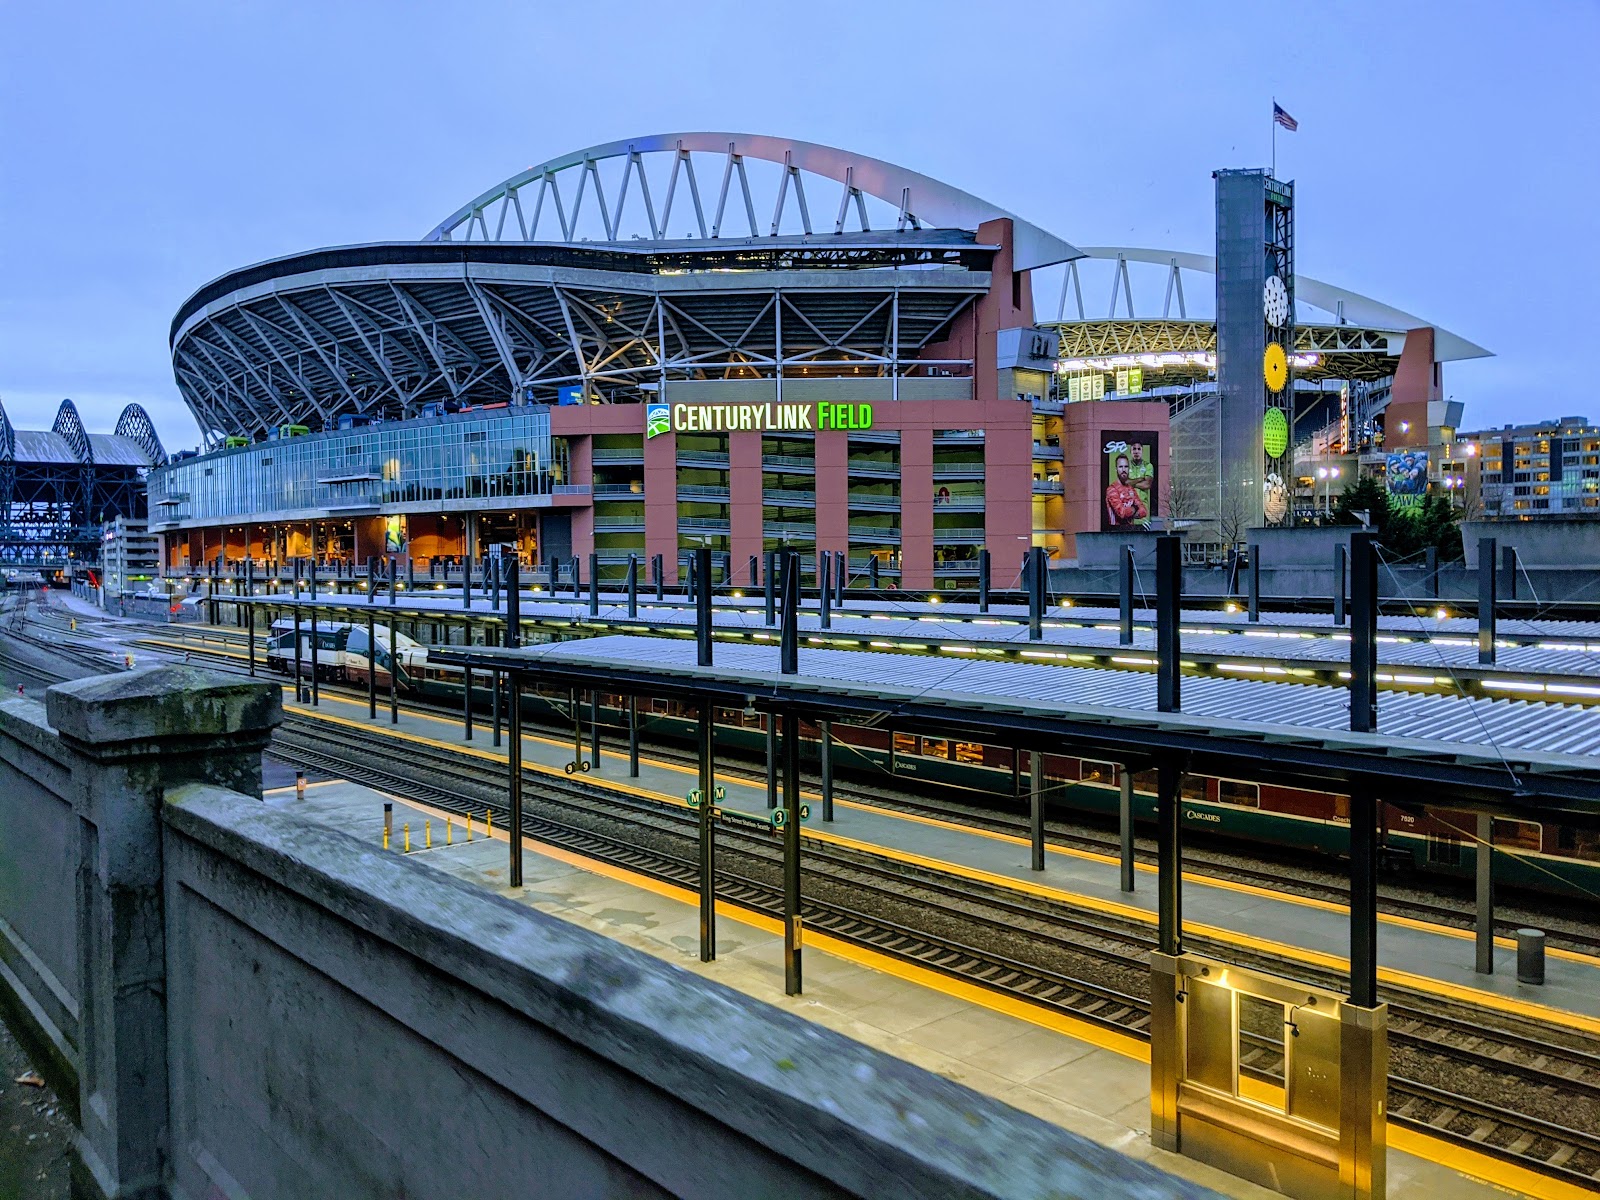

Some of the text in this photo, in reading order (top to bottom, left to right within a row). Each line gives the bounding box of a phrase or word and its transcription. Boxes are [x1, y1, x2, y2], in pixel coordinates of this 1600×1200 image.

[817, 401, 872, 430] FIELD
[1103, 441, 1128, 453] SFC
[568, 764, 573, 773] 9
[583, 762, 589, 771] 9
[691, 792, 700, 803] M
[715, 788, 724, 798] M
[776, 811, 783, 823] 3
[801, 807, 808, 817] 4
